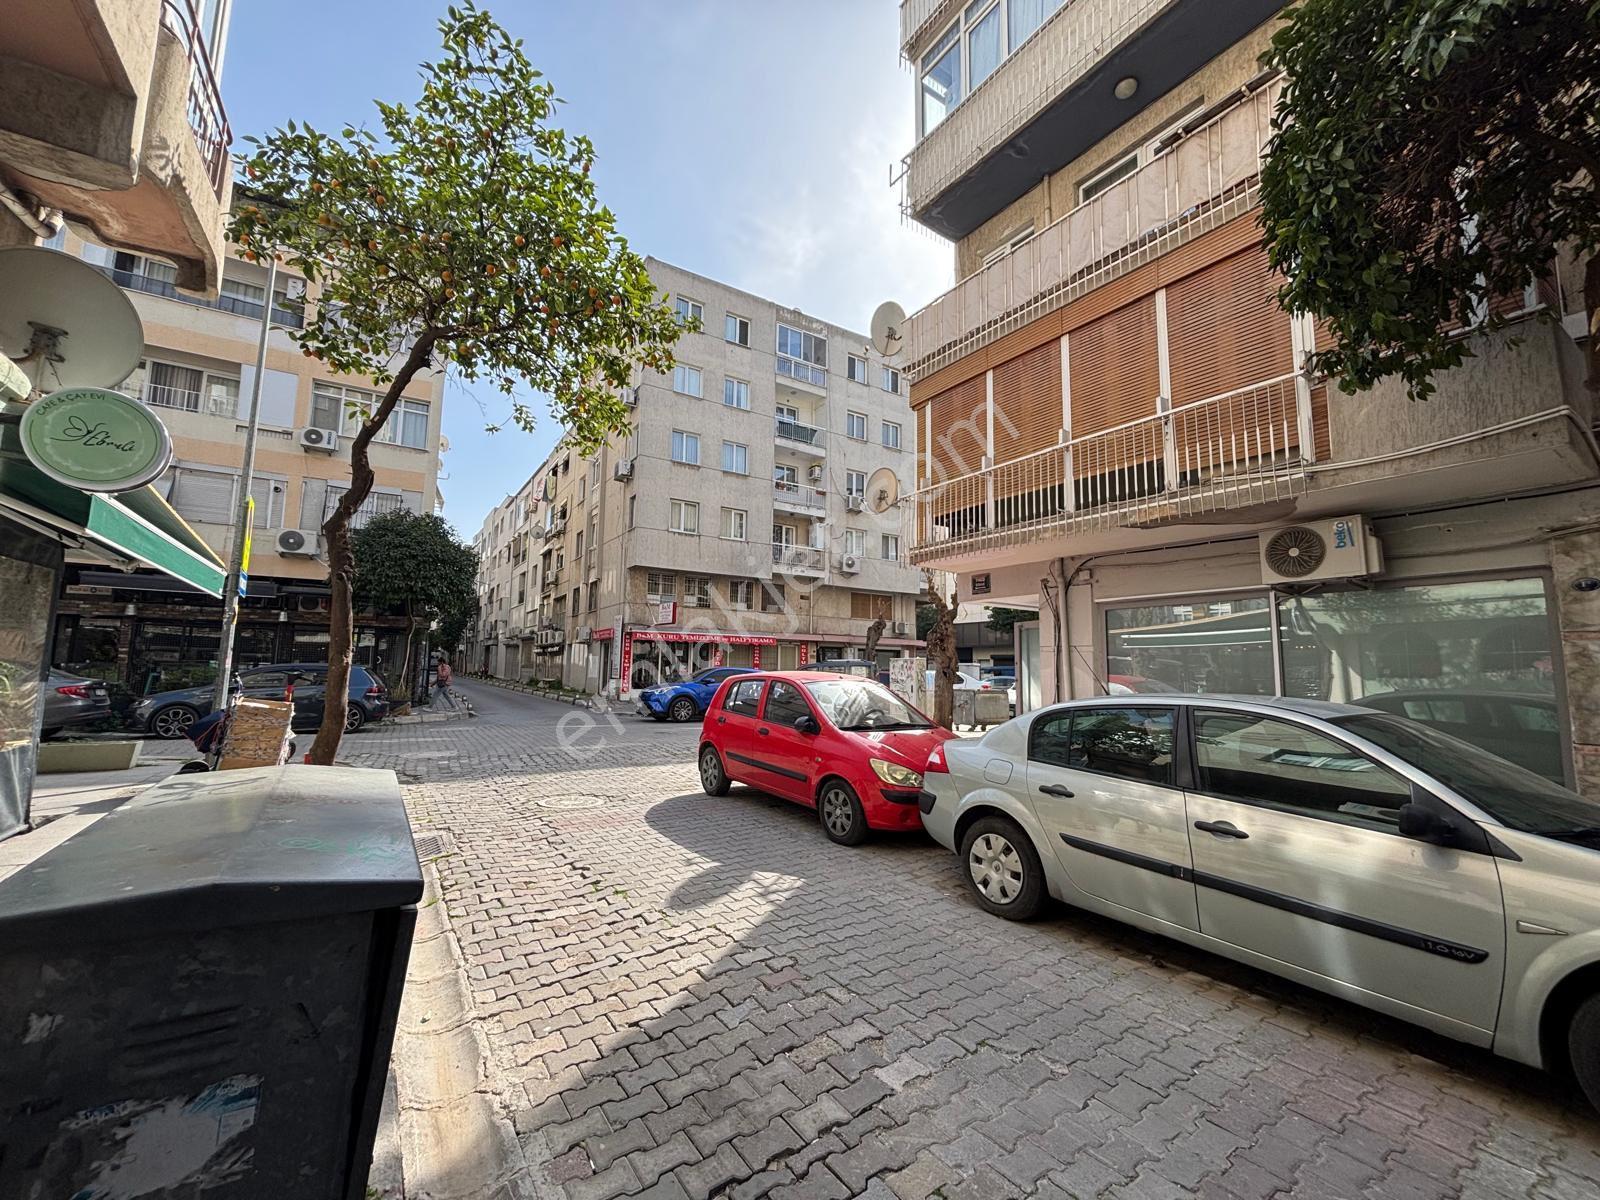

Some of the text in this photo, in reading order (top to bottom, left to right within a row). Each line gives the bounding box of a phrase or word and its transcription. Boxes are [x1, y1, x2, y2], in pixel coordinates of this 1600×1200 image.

[36, 397, 56, 416] CAFE
[57, 396, 65, 404] &
[66, 392, 87, 402] ÇAY
[1334, 521, 1346, 548] beko
